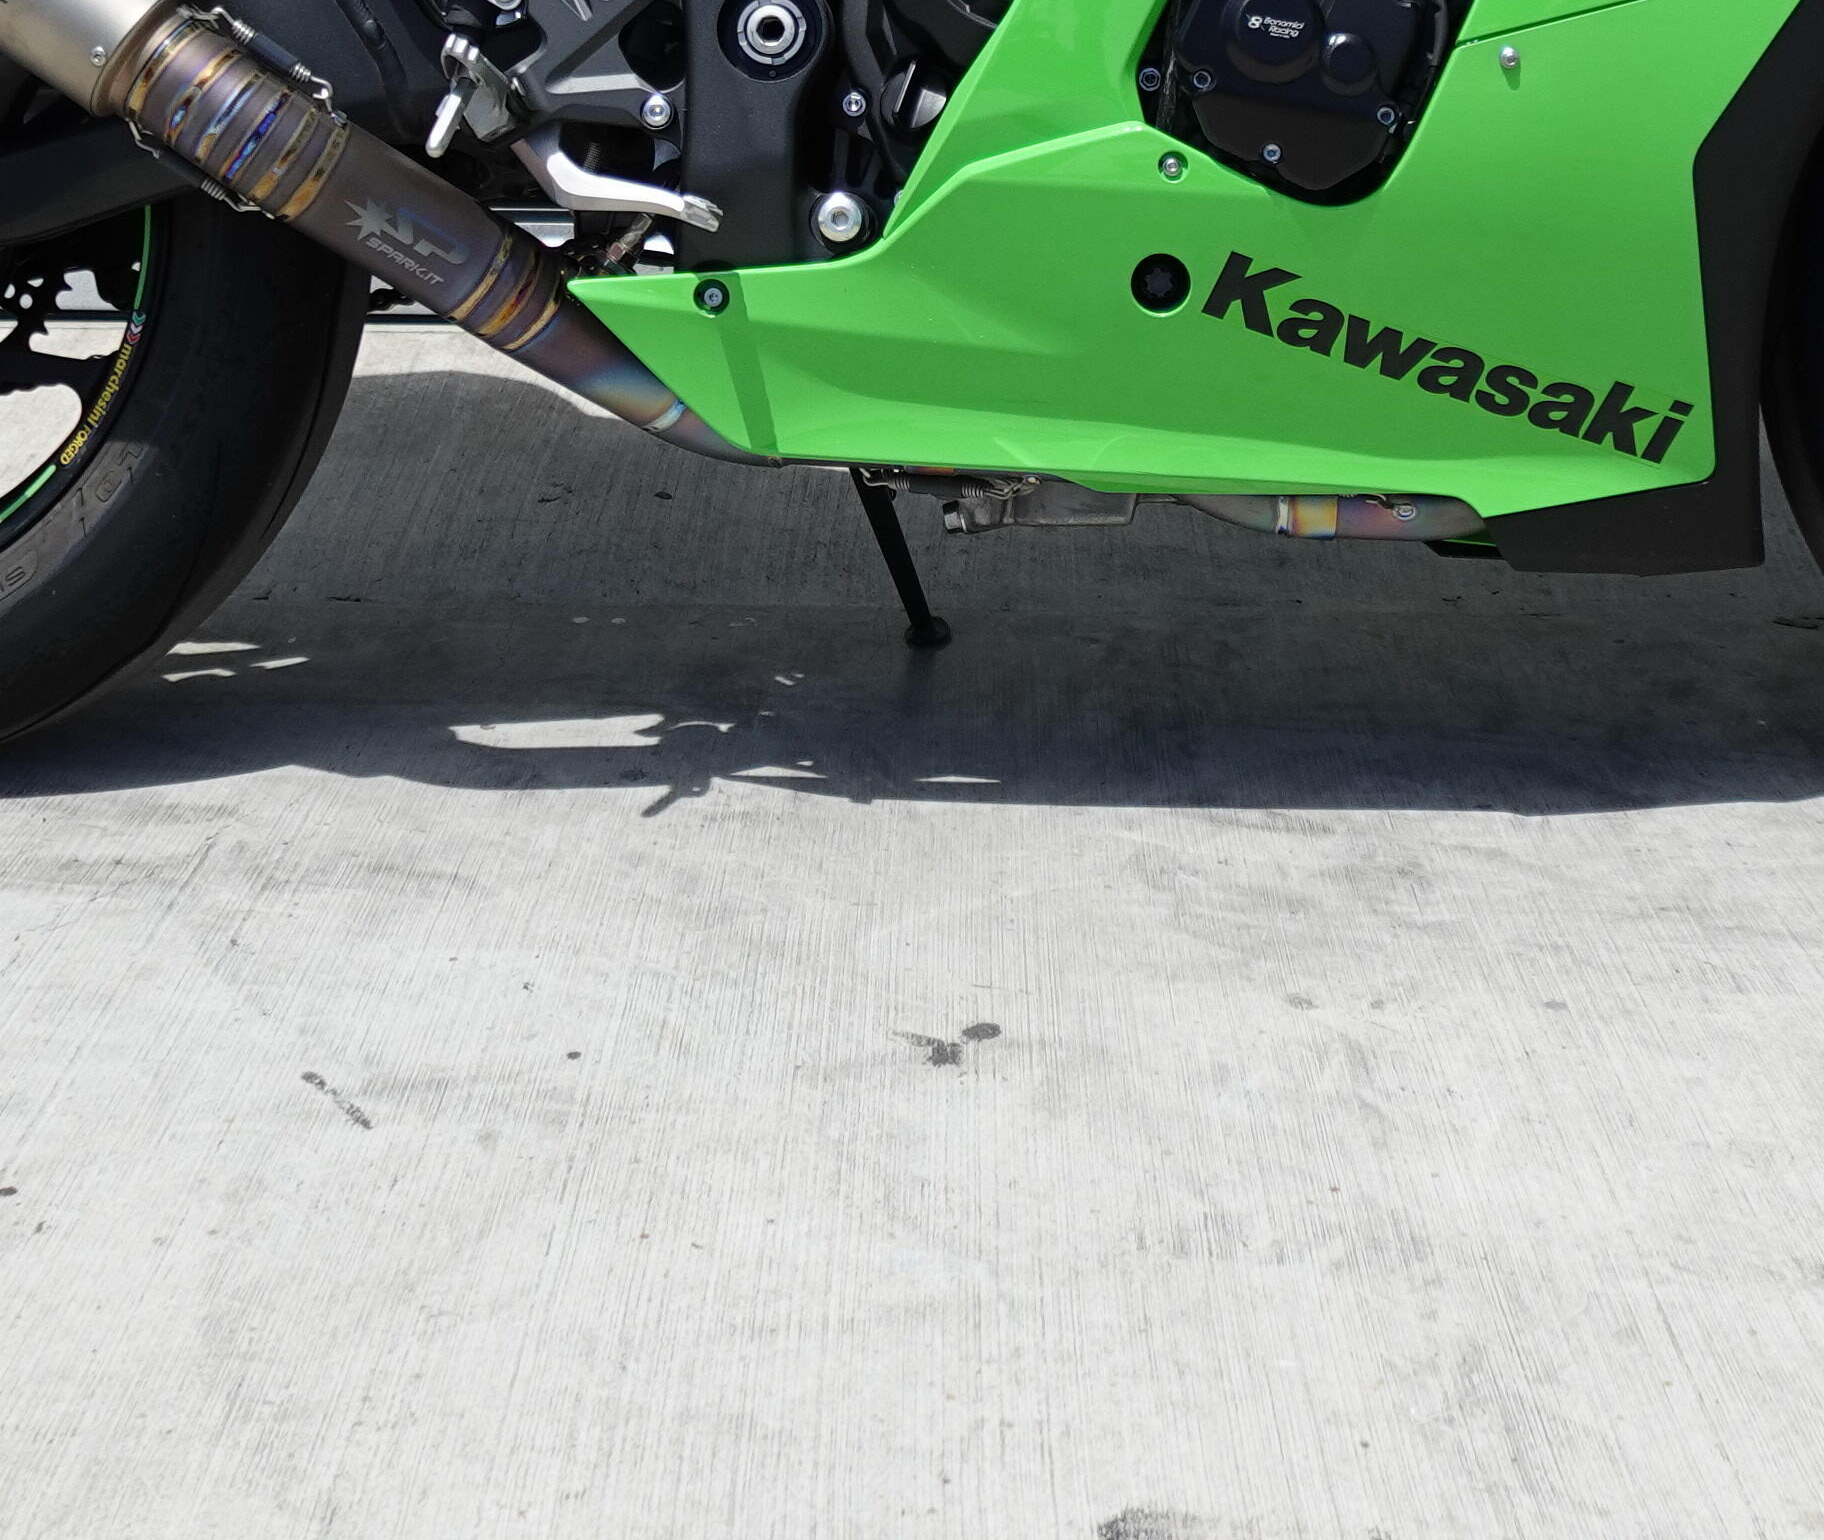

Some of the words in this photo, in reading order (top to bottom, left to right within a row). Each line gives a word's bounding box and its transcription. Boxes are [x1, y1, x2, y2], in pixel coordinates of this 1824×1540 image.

[87, 343, 133, 428] marchesini
[1201, 250, 1695, 465] Kawasaki
[59, 424, 92, 466] FORGED
